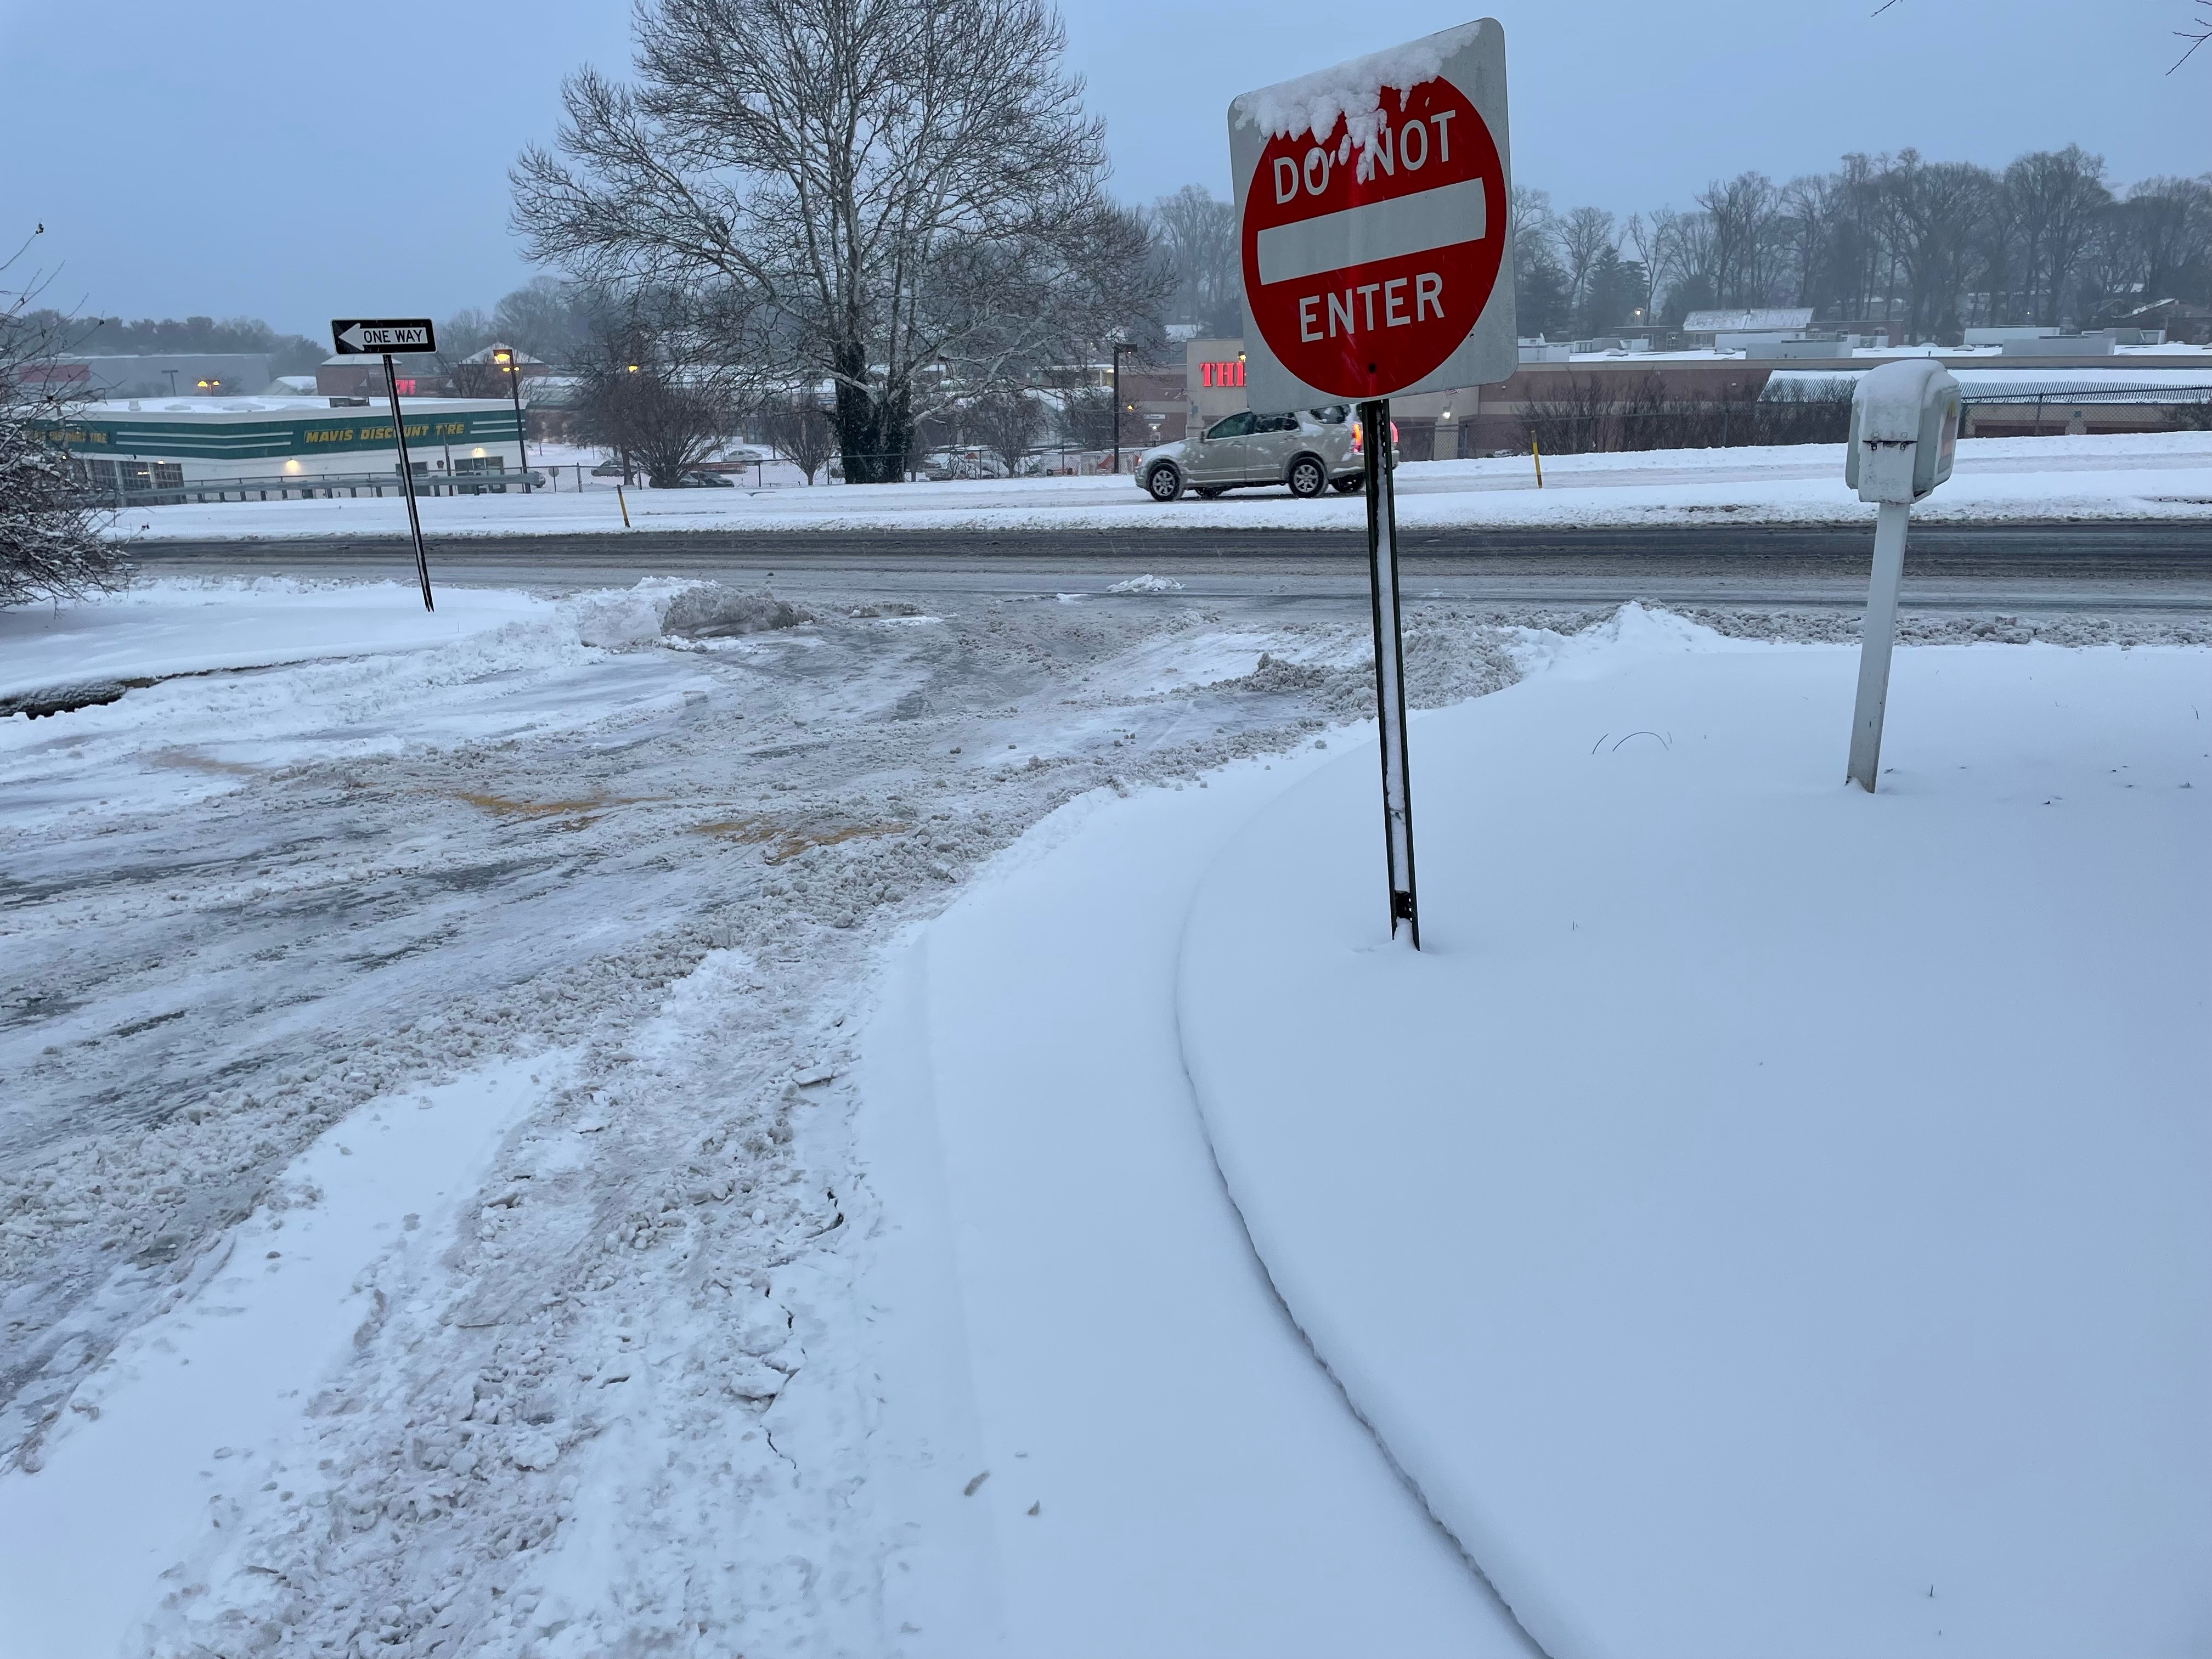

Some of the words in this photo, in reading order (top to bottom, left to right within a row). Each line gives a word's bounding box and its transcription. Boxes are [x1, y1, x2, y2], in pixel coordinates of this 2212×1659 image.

[1274, 147, 1329, 204] DO
[1368, 109, 1456, 181] NOT
[1299, 272, 1446, 343] ENTER
[363, 330, 391, 344] ONE
[394, 329, 422, 343] WAY
[306, 429, 354, 443] MAVIS
[360, 425, 430, 440] DISCUNT
